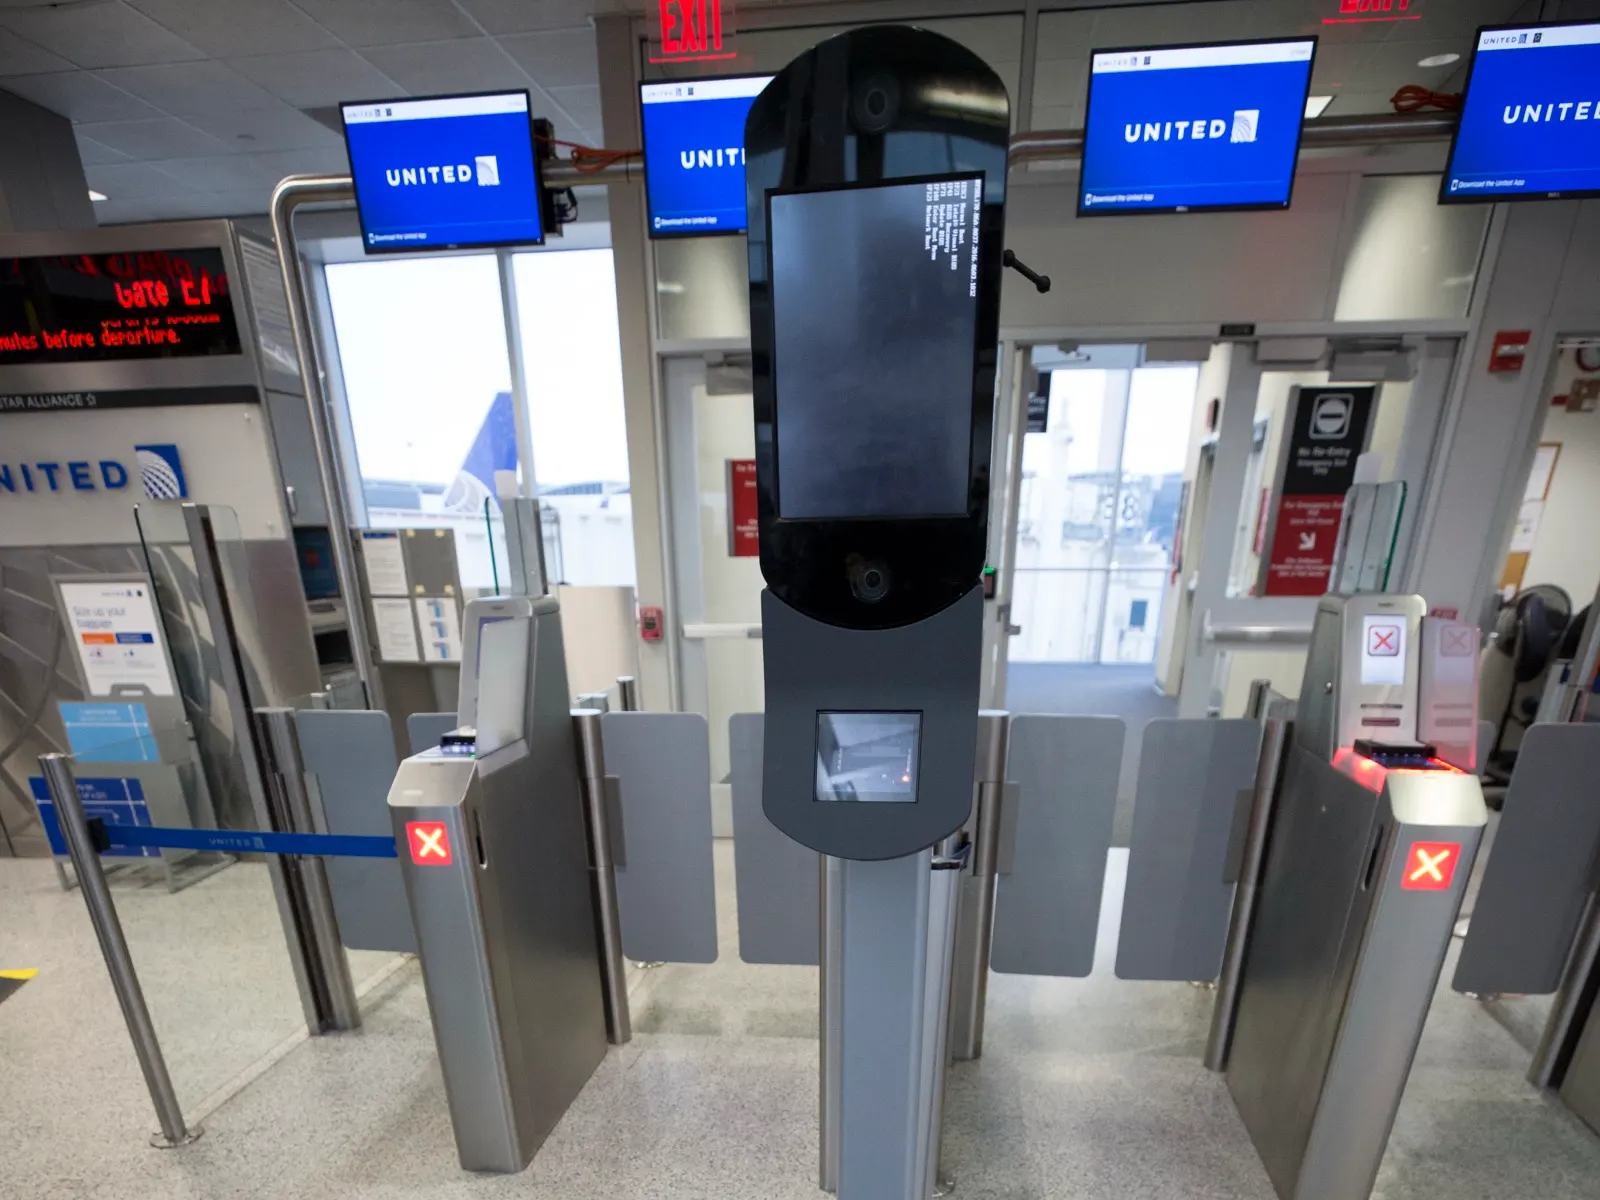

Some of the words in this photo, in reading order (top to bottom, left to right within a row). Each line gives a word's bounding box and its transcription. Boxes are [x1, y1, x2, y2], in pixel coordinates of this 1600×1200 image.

[1483, 36, 1517, 44] UNITED
[1125, 119, 1226, 143] UNITED
[386, 164, 472, 187] UNITED
[42, 329, 96, 349] before
[101, 326, 181, 346] departure.
[27, 393, 84, 409] ALLIANCE
